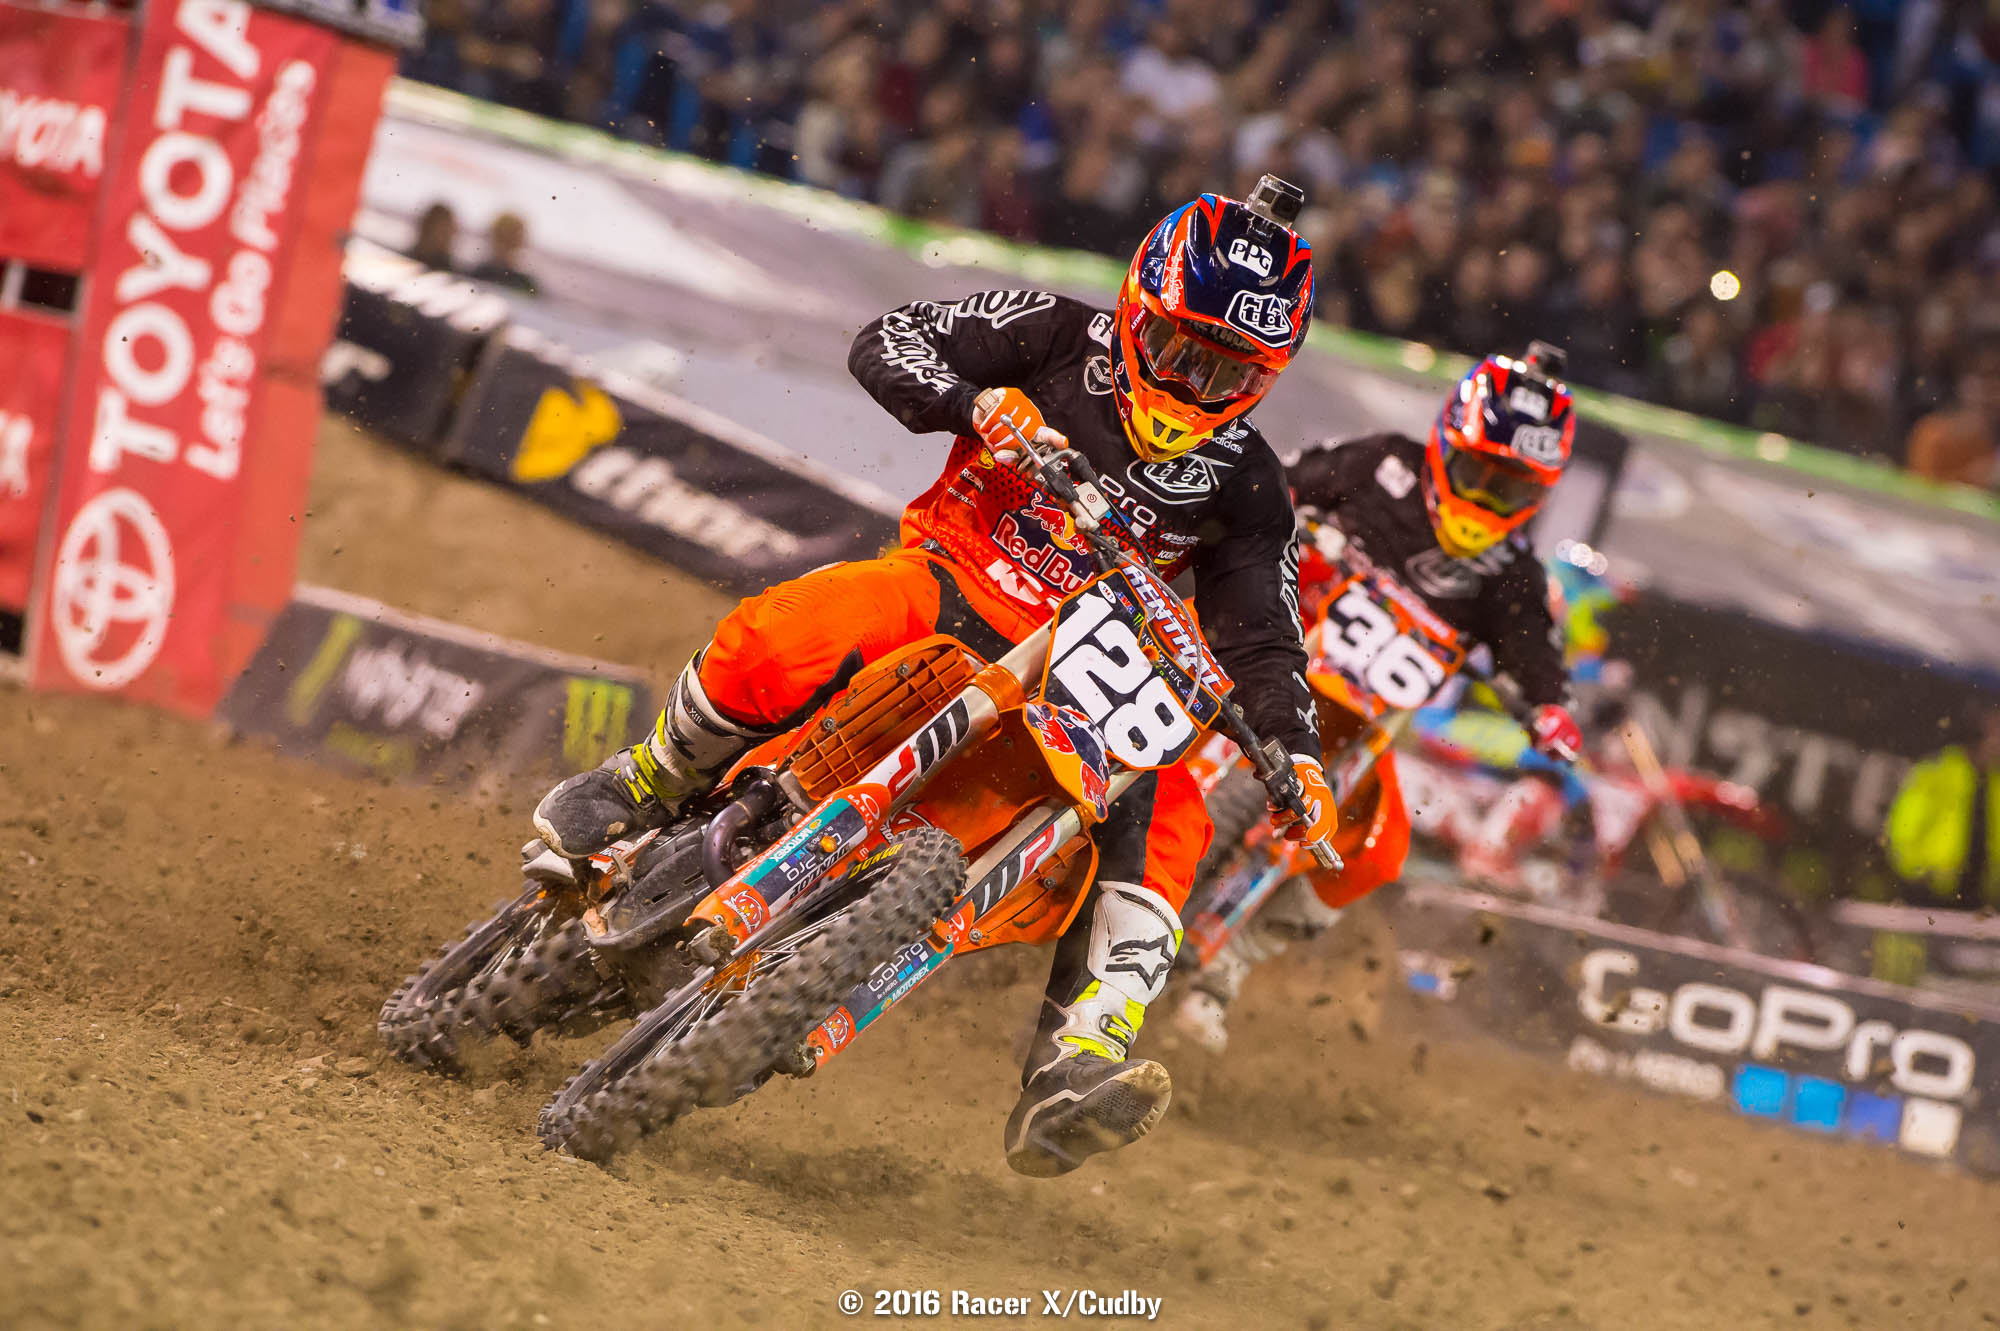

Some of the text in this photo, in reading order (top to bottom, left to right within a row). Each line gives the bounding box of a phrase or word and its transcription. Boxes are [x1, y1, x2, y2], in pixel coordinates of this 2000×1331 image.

[90, 0, 260, 473] TOYOTA
[1231, 241, 1273, 272] PPG
[1211, 436, 1244, 455] didas
[1122, 564, 1223, 694] RENTHAL
[1322, 581, 1447, 711] 36
[1049, 592, 1194, 768] 128
[769, 827, 815, 863] MOTOREX
[786, 842, 853, 901] DUNLOP
[867, 942, 923, 993] GoPro
[891, 963, 930, 1001] MOTOREX
[1577, 948, 1976, 1099] GoPro
